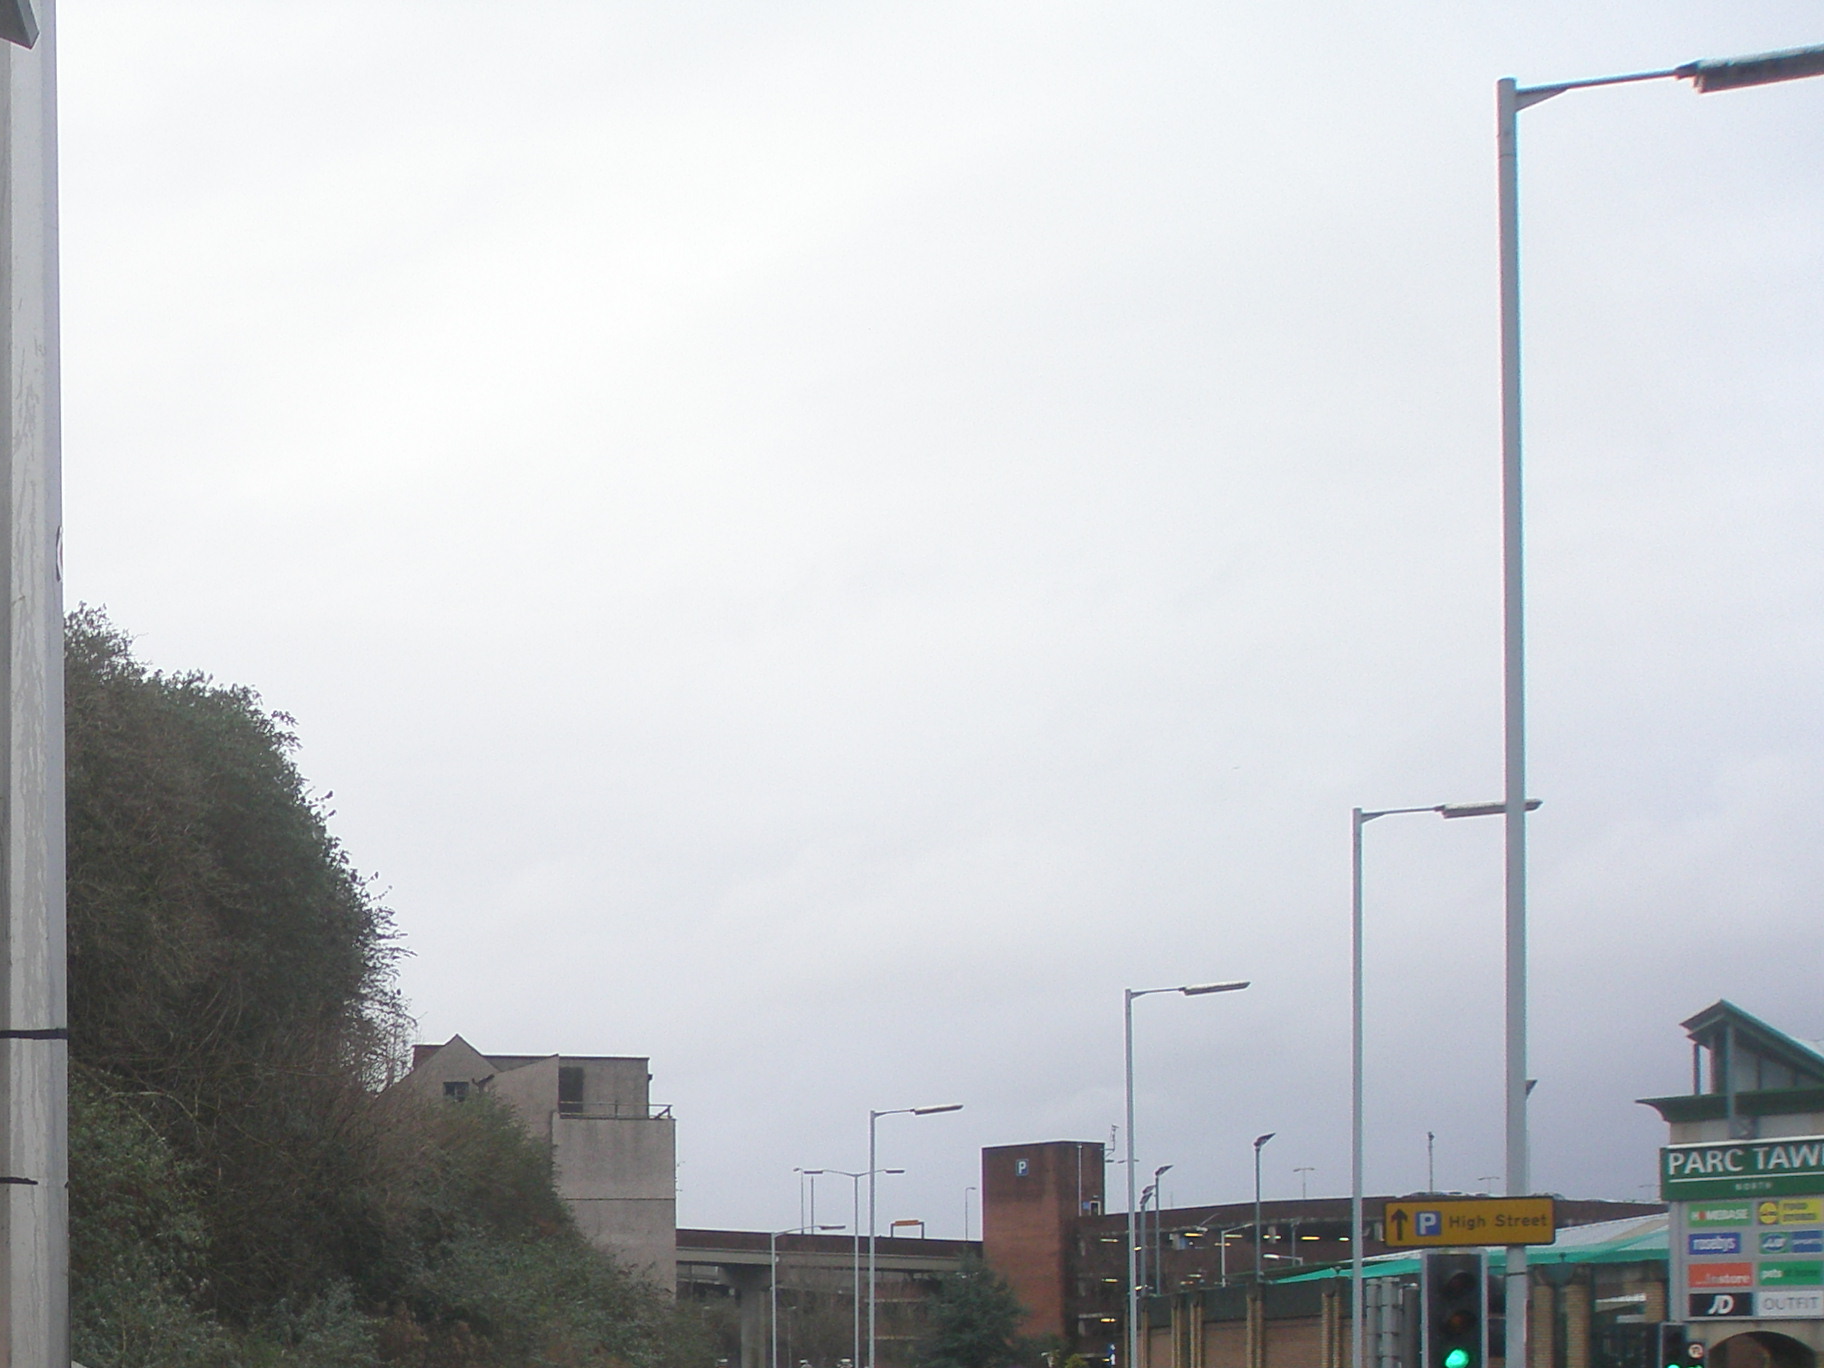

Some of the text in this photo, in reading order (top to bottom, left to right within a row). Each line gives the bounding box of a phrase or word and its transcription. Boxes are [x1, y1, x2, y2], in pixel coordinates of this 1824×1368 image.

[1018, 1161, 1027, 1174] P
[1667, 1143, 1824, 1175] PARC TAW
[1419, 1213, 1548, 1235] P High Street
[1707, 1294, 1735, 1315] JD
[1763, 1296, 1820, 1311] OUTFIT
